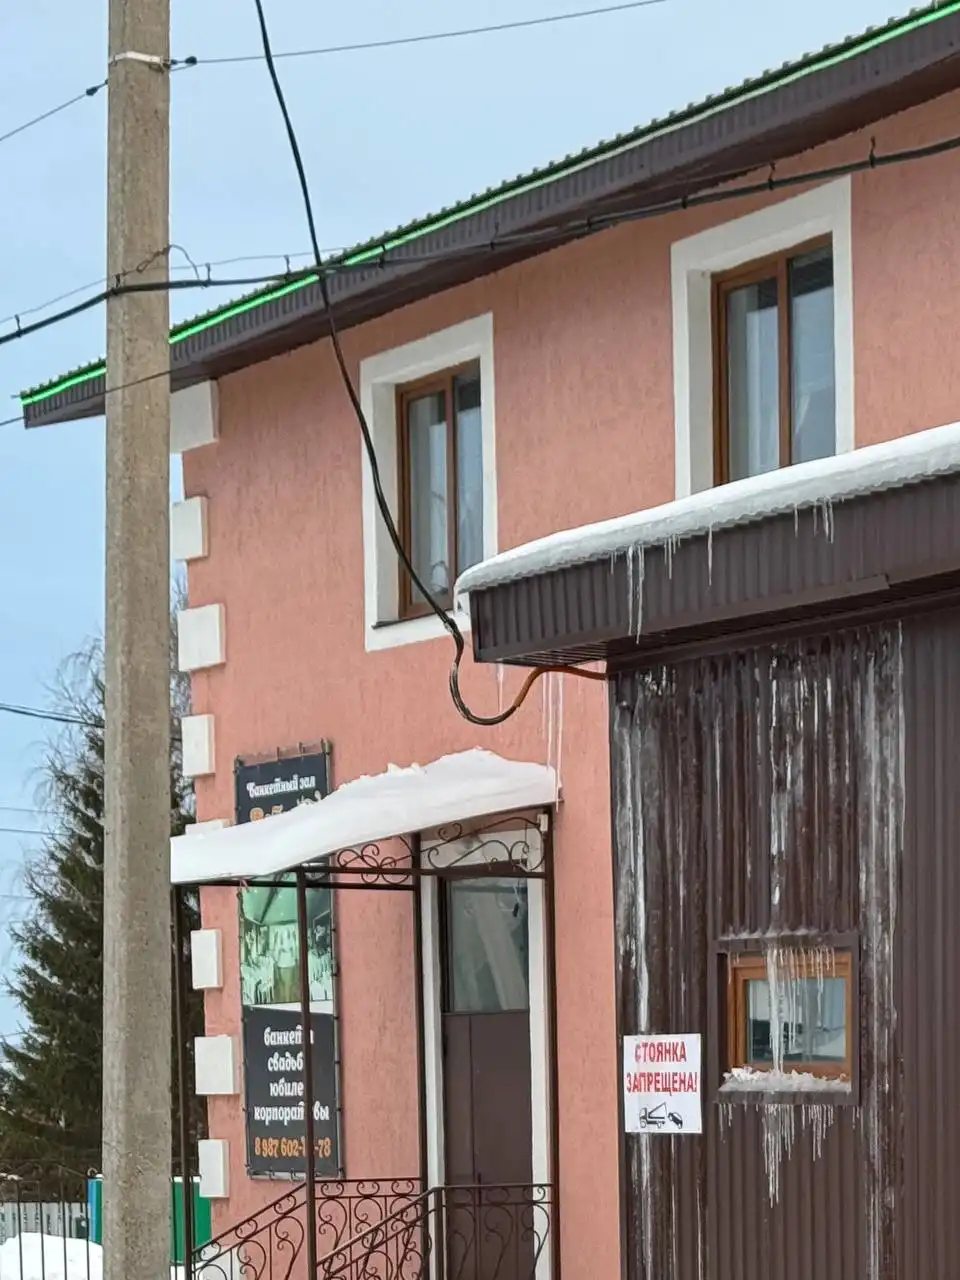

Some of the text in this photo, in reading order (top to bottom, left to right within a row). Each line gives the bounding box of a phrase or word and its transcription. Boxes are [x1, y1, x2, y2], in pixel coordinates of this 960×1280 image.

[246, 774, 316, 798] Банкетный зал
[263, 1024, 314, 1046] банкет
[267, 1051, 304, 1072] свадьб
[634, 1041, 687, 1063] СТОЯНКА
[269, 1077, 304, 1097] юбиле
[626, 1071, 698, 1096] ЗАПРЕЩЕНА!
[253, 1101, 330, 1126] корпоратвы
[261, 1137, 279, 1158] 987
